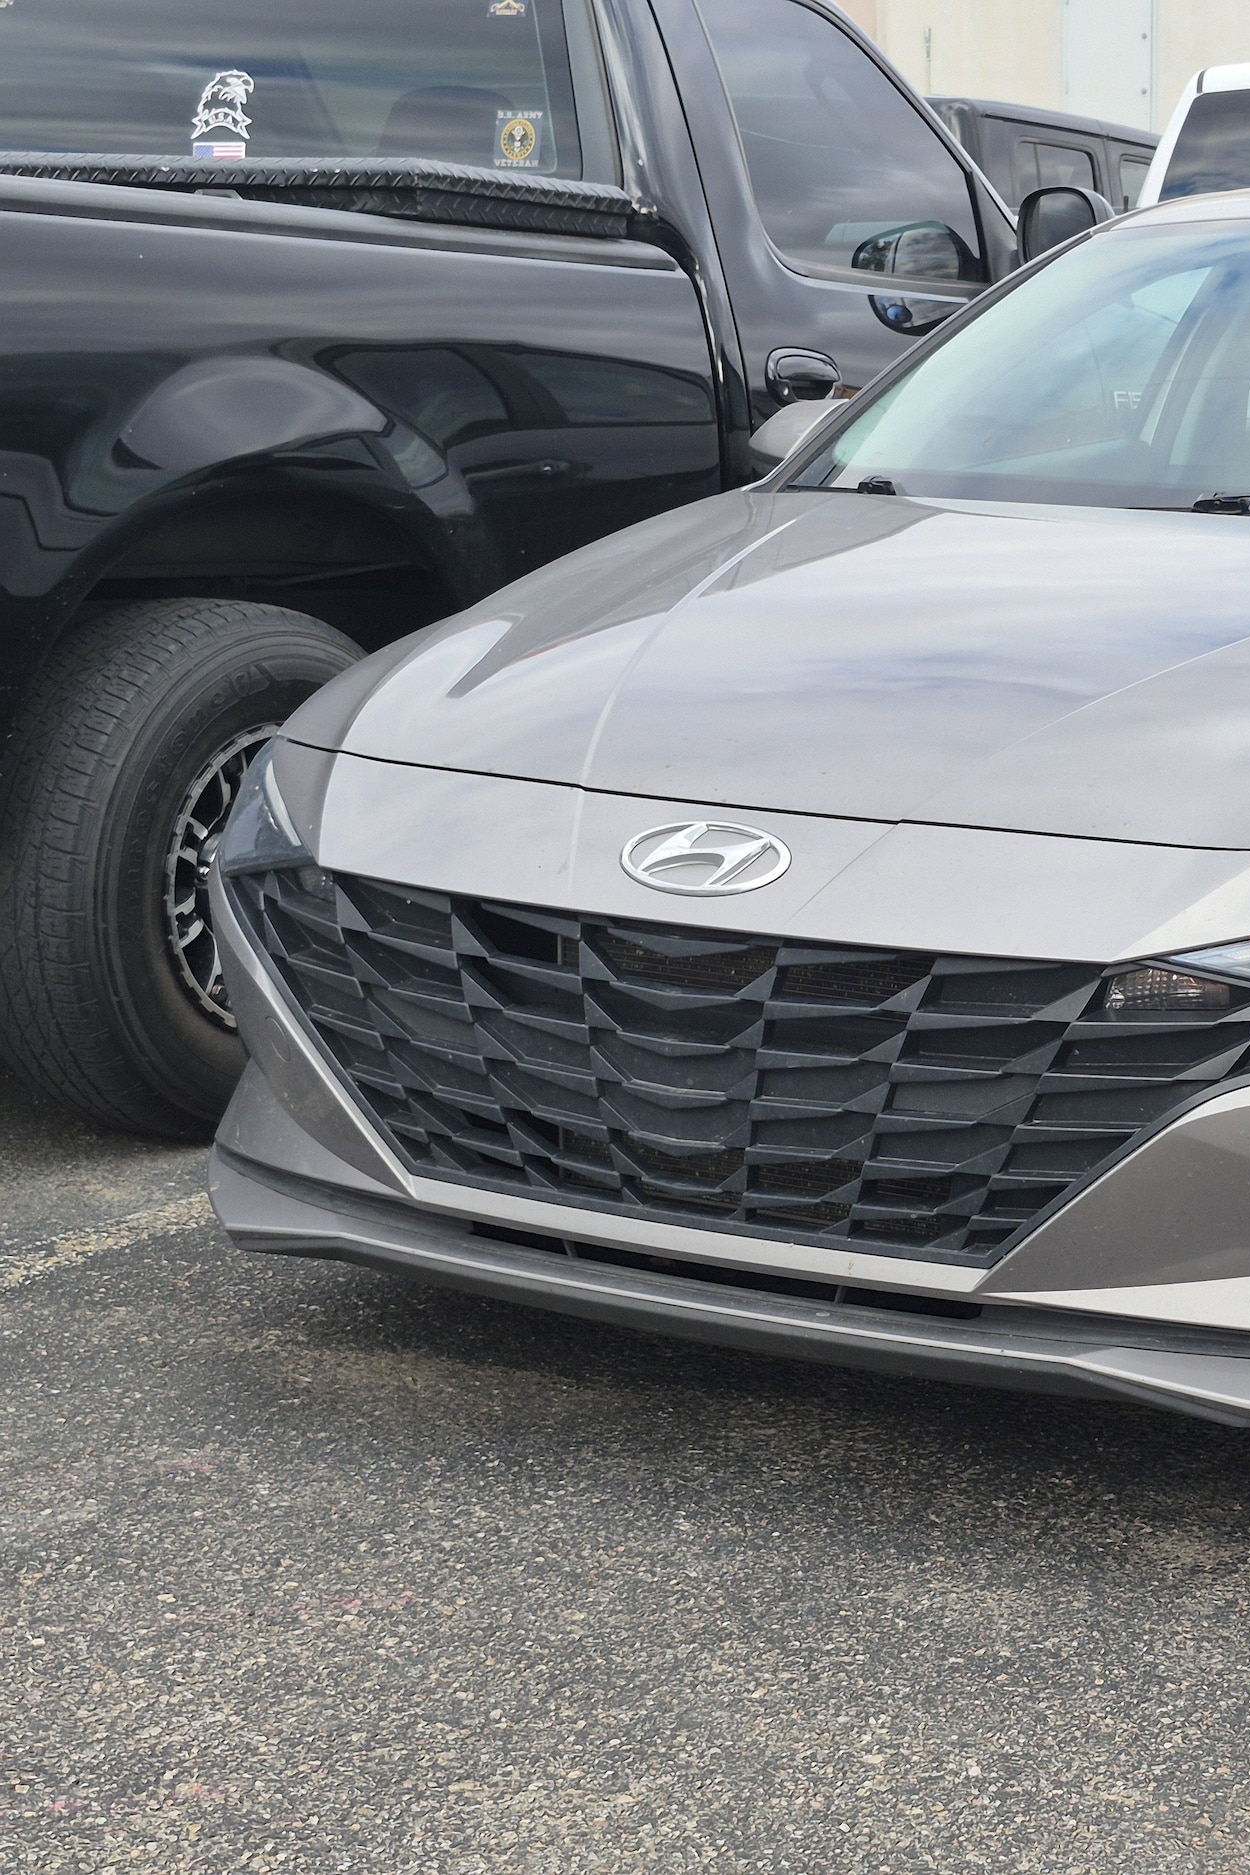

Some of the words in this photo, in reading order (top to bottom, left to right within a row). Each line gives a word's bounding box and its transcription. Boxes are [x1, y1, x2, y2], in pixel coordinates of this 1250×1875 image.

[208, 112, 235, 126] U.S.A.
[517, 111, 544, 119] ARMY
[494, 159, 539, 167] VETERAN
